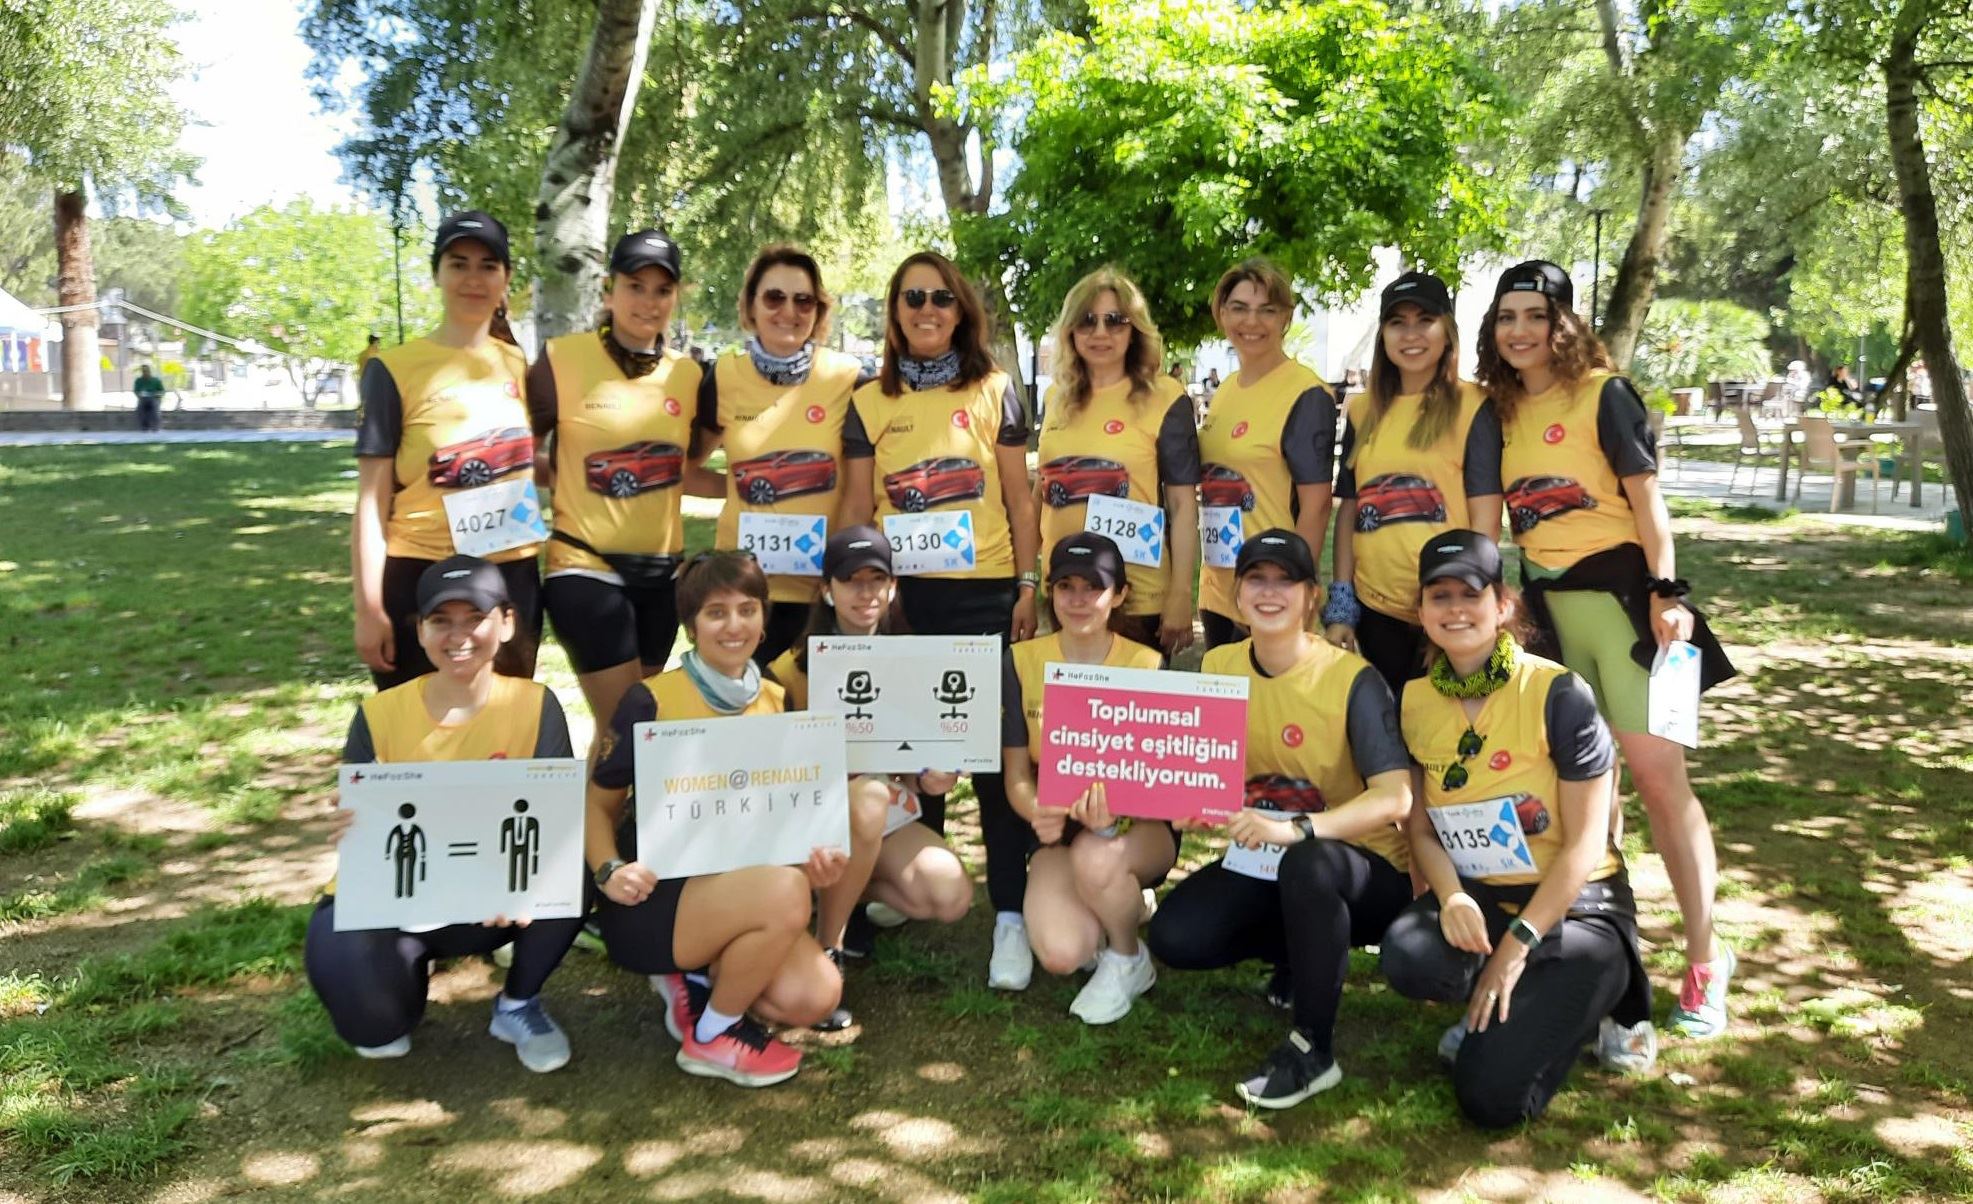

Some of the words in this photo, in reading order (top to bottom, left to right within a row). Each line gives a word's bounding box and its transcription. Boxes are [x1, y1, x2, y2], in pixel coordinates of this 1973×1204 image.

[456, 509, 507, 535] 4027
[1091, 515, 1137, 538] 3128
[744, 534, 791, 552] 3131
[891, 533, 941, 553] 3130
[1087, 698, 1200, 727] Toplumsal
[845, 721, 873, 734] %50
[940, 721, 969, 733] %50
[1049, 725, 1135, 754] cinsiyet
[1140, 733, 1239, 763] eşitliğini
[664, 764, 822, 795] WOMEN@RENAULT
[1056, 753, 1227, 790] destekliyorum.
[666, 790, 823, 820] TÜRKİYE
[1441, 828, 1491, 850] 3135
